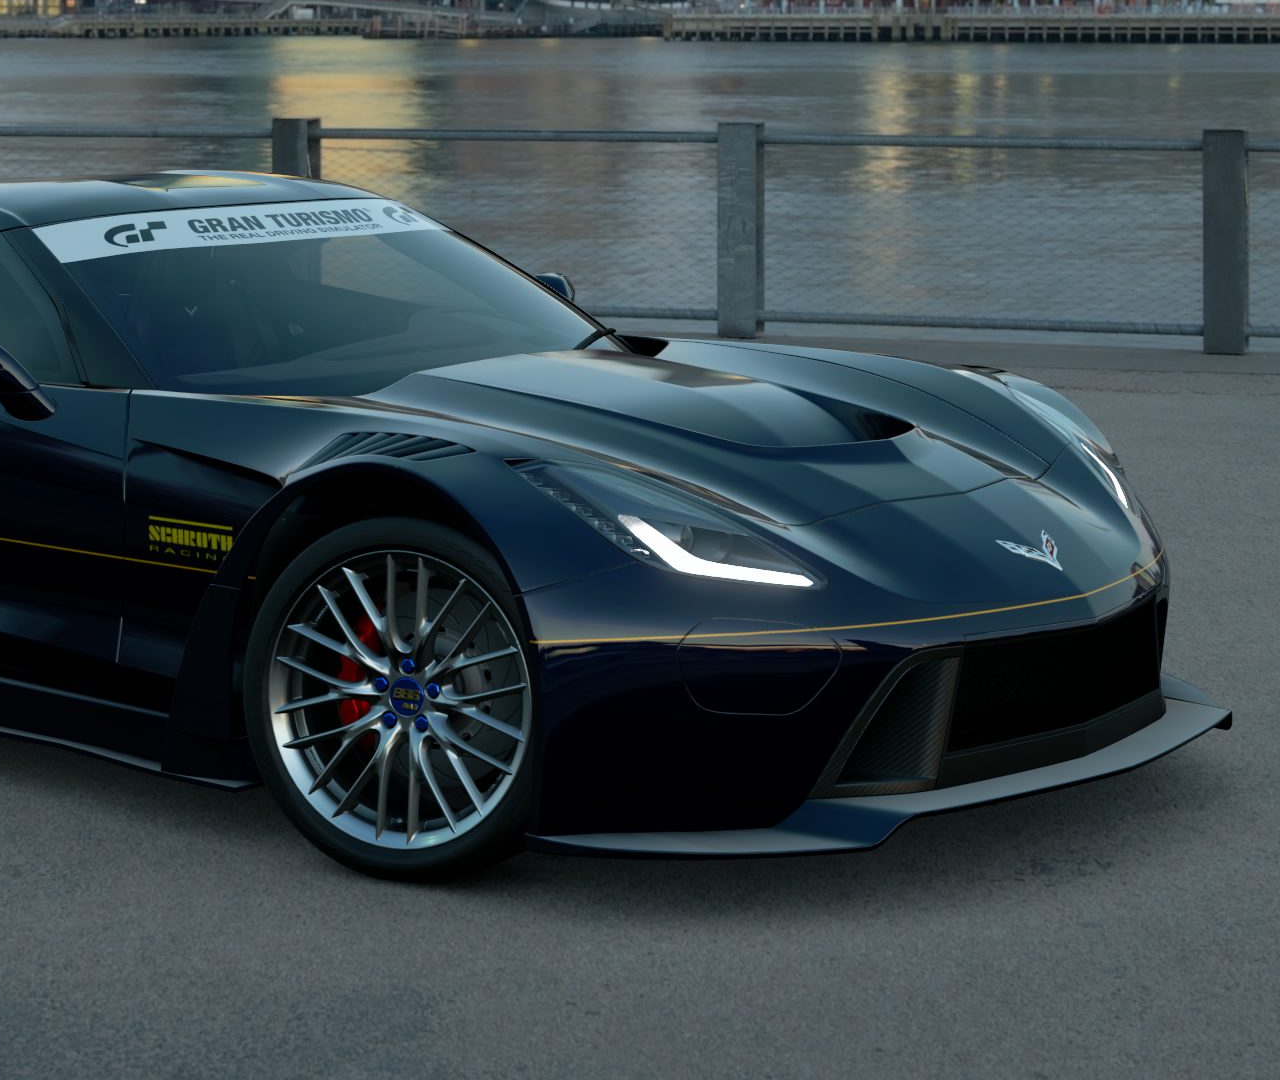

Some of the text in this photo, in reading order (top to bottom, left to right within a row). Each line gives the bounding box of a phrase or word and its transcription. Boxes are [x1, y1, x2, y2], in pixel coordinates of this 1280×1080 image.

[187, 207, 374, 234] GRAN TURISMO
[197, 223, 384, 242] THE REAL DRIVING SIMULATOR
[148, 525, 233, 552] SCHROTH
